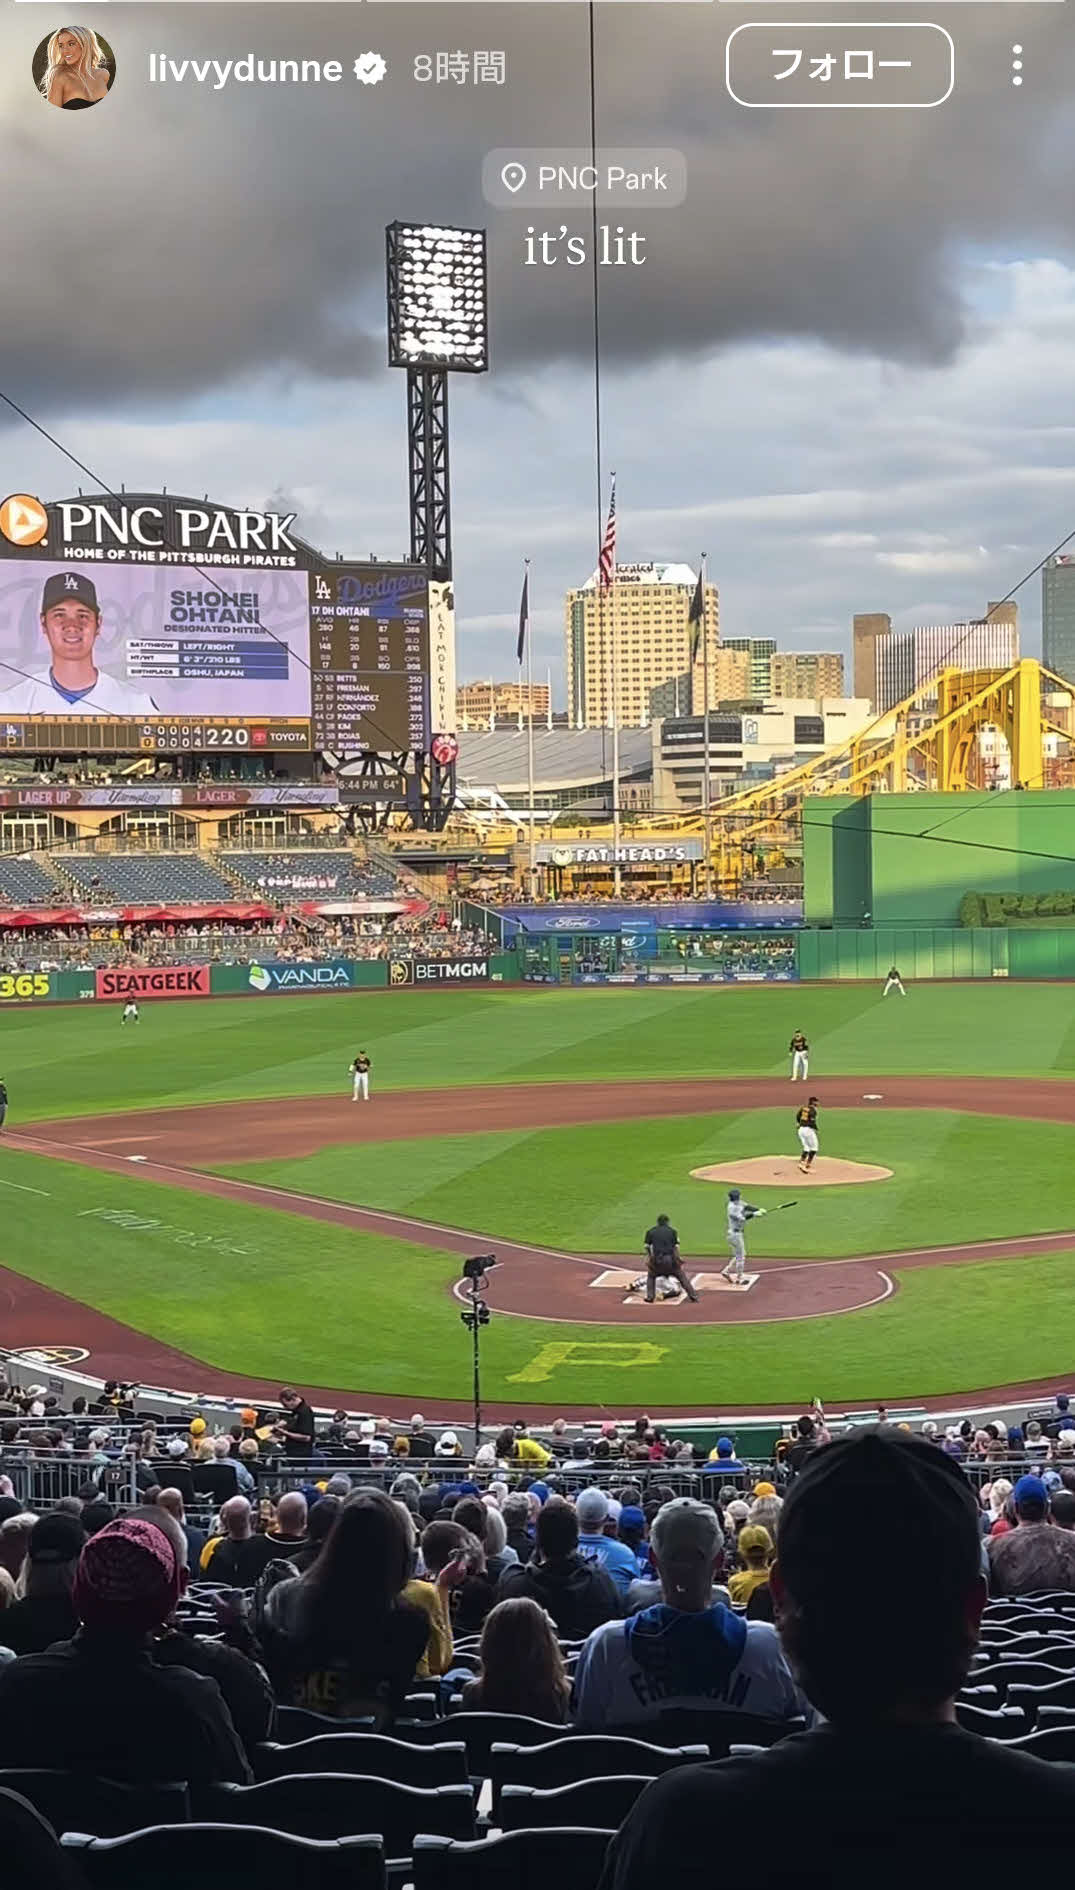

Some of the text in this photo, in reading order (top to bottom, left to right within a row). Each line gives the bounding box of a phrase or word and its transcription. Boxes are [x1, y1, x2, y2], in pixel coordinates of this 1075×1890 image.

[56, 502, 298, 552] PNC PARK
[64, 547, 297, 567] HOME OF THE PITTSBURGH PIRATES
[315, 573, 427, 604] LA Dodgers
[170, 590, 259, 608] SHOHEI
[170, 607, 260, 624] OHTANI
[311, 606, 370, 616] 17 DH OHTANI
[164, 624, 267, 635] DESIGNATED HITTER
[183, 643, 236, 651] LEFT/RIGHT
[183, 669, 214, 677] OSHU,
[270, 733, 307, 741] TOYOTA
[338, 780, 360, 790] 6:44
[362, 780, 379, 789] PM
[18, 790, 53, 805] LAGER
[56, 790, 71, 804] UP
[196, 790, 236, 803] LAGER
[576, 848, 685, 862] FAT HEAD'S
[555, 917, 590, 929] Ford
[272, 967, 350, 985] VANDA
[416, 962, 487, 980] BETMGM
[0, 974, 50, 997] 365
[102, 971, 202, 995] SEATGEEK
[111, 1472, 121, 1480] 17
